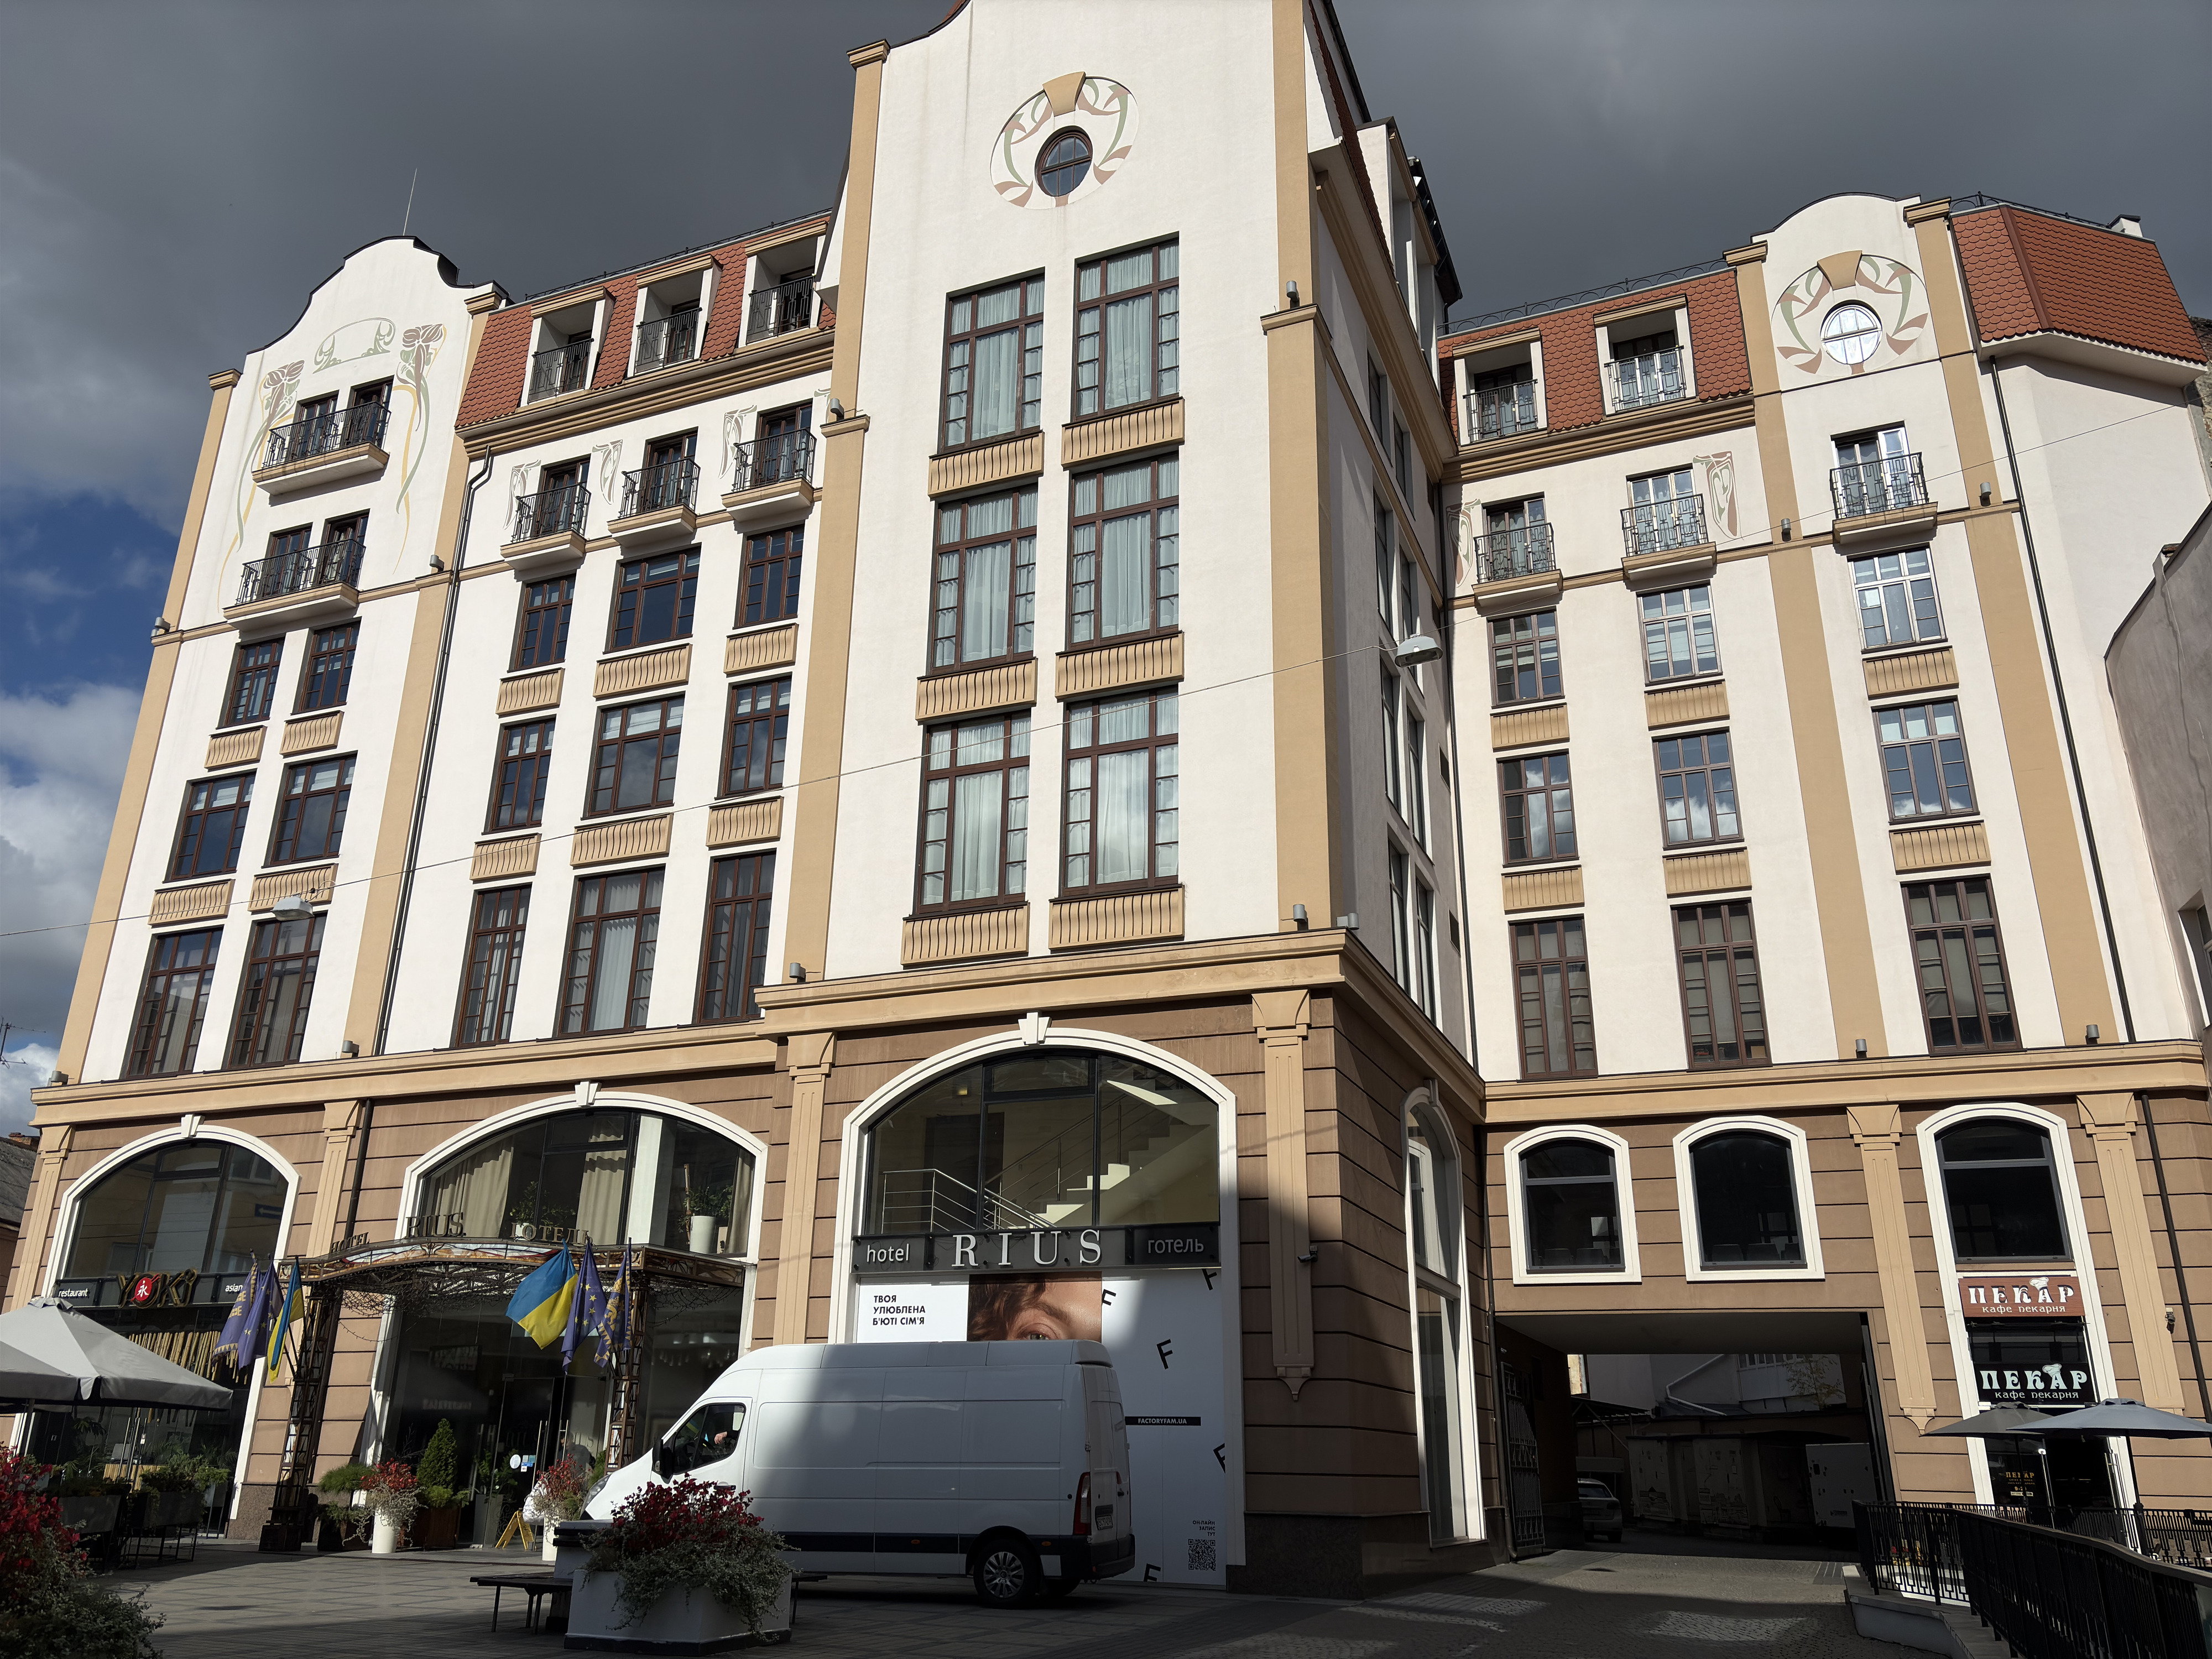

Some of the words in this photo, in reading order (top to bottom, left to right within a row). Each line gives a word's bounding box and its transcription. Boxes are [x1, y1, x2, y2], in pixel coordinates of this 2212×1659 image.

[405, 1212, 466, 1238] RIUS
[509, 1222, 593, 1245] ГОТЕЛЬ
[331, 1232, 370, 1254] HOTEL
[866, 1243, 910, 1262] hotel
[951, 1229, 1102, 1267] RIUS
[1147, 1235, 1204, 1255] готель
[58, 1287, 88, 1297] restaurant
[225, 1284, 243, 1292] asian
[1968, 1284, 2075, 1304] ПЕКАР
[873, 1295, 897, 1303] ТВОЯ
[873, 1305, 926, 1314] УЛЮБЛЕНА
[1982, 1305, 2012, 1314] кафе
[2018, 1305, 2066, 1314] пекарня
[872, 1317, 898, 1326] Б'ЮТІ
[900, 1317, 925, 1325] СІМ'Я
[1156, 1339, 1173, 1370] F
[1979, 1370, 2088, 1390] ПЕКАР
[1995, 1391, 2026, 1400] кафе
[2031, 1391, 2079, 1400] пекарня
